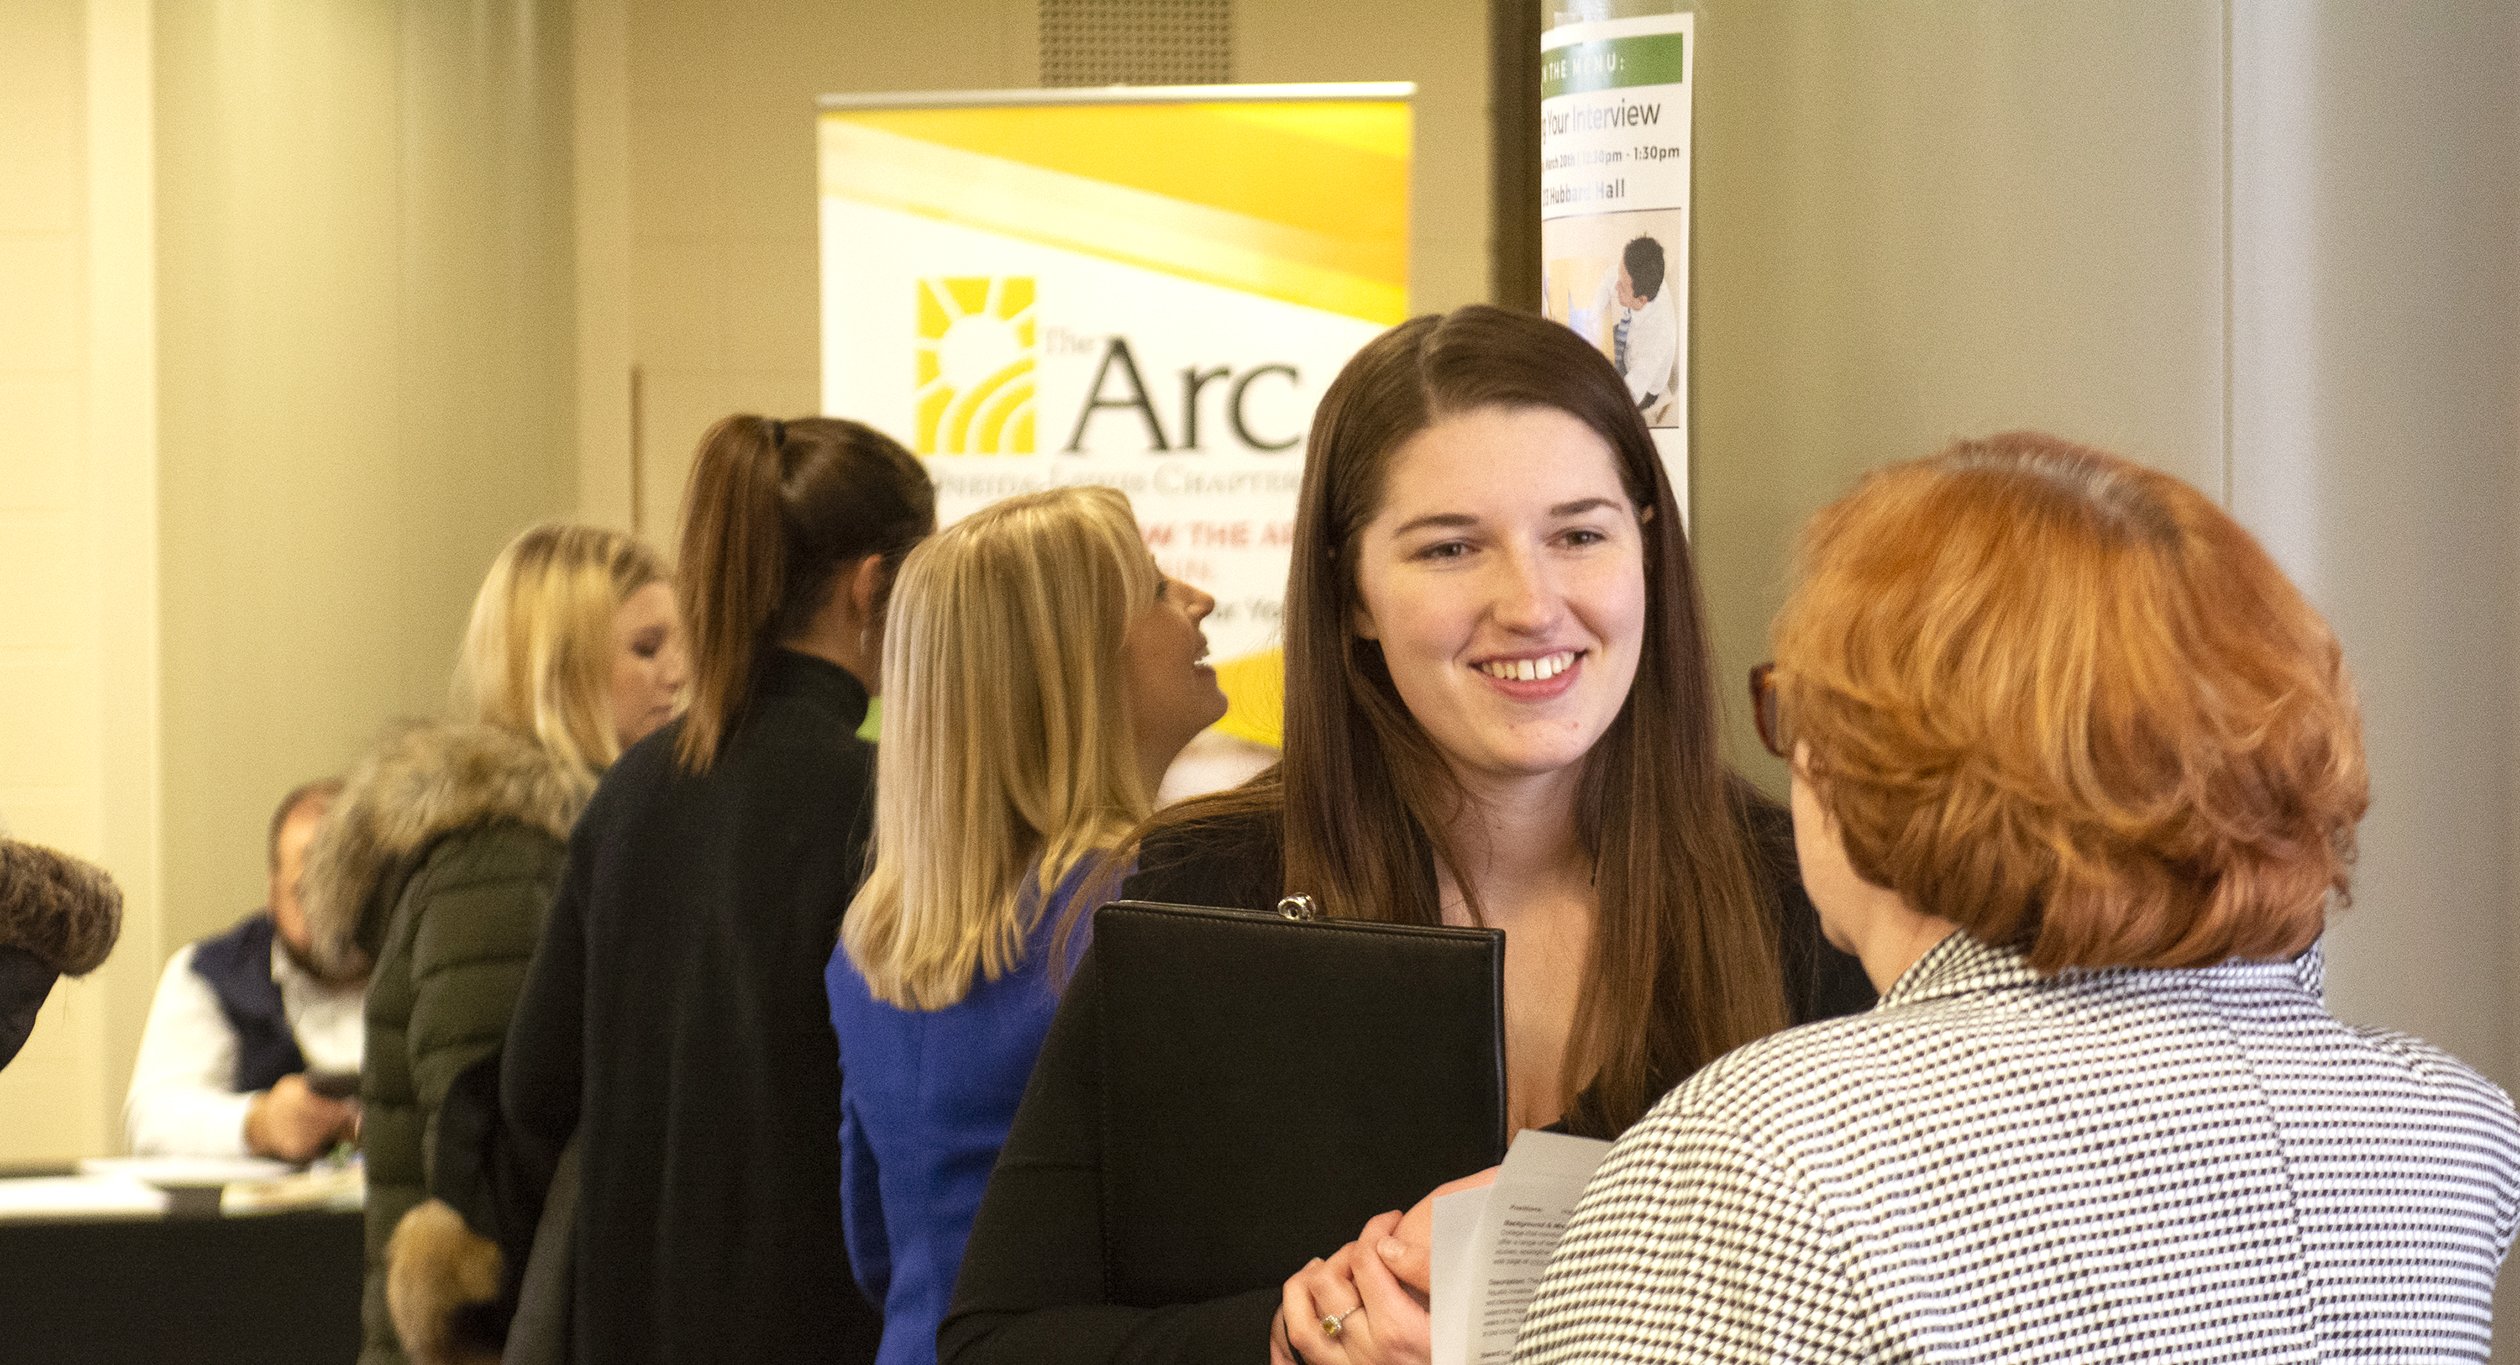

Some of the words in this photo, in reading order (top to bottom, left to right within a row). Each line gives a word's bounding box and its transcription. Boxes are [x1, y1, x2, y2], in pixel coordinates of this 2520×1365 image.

[1547, 107, 1570, 136] Your
[1573, 97, 1662, 132] Interview
[1634, 145, 1680, 162] 1:30pm
[1596, 177, 1626, 200] Hall
[1063, 336, 1300, 455] Arc
